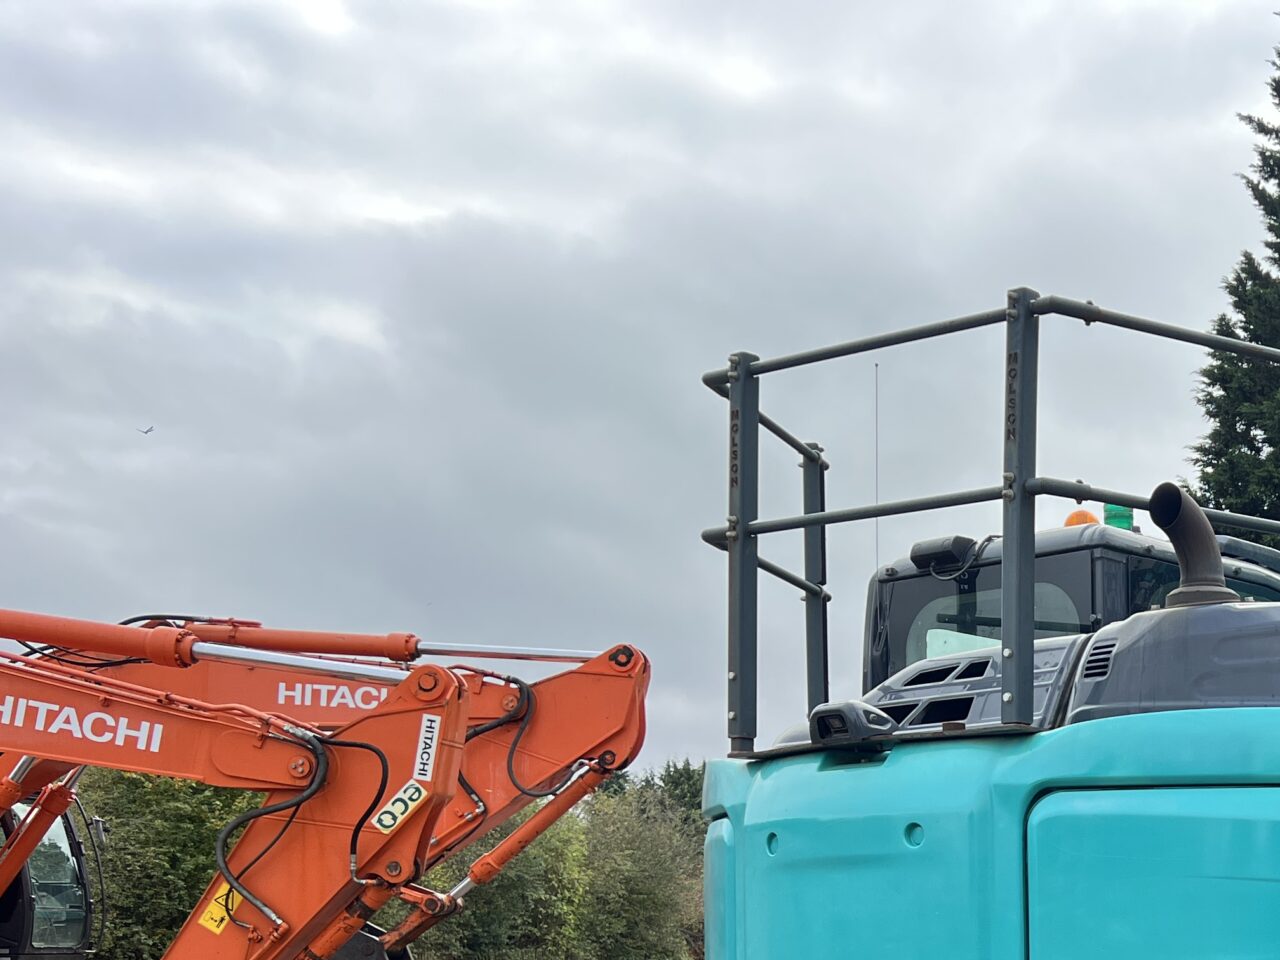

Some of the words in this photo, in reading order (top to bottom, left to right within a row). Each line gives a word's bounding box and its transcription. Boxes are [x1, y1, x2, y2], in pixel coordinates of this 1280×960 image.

[1007, 351, 1018, 441] MOLSON
[731, 409, 739, 488] MOLSON
[417, 718, 437, 777] HITACHI
